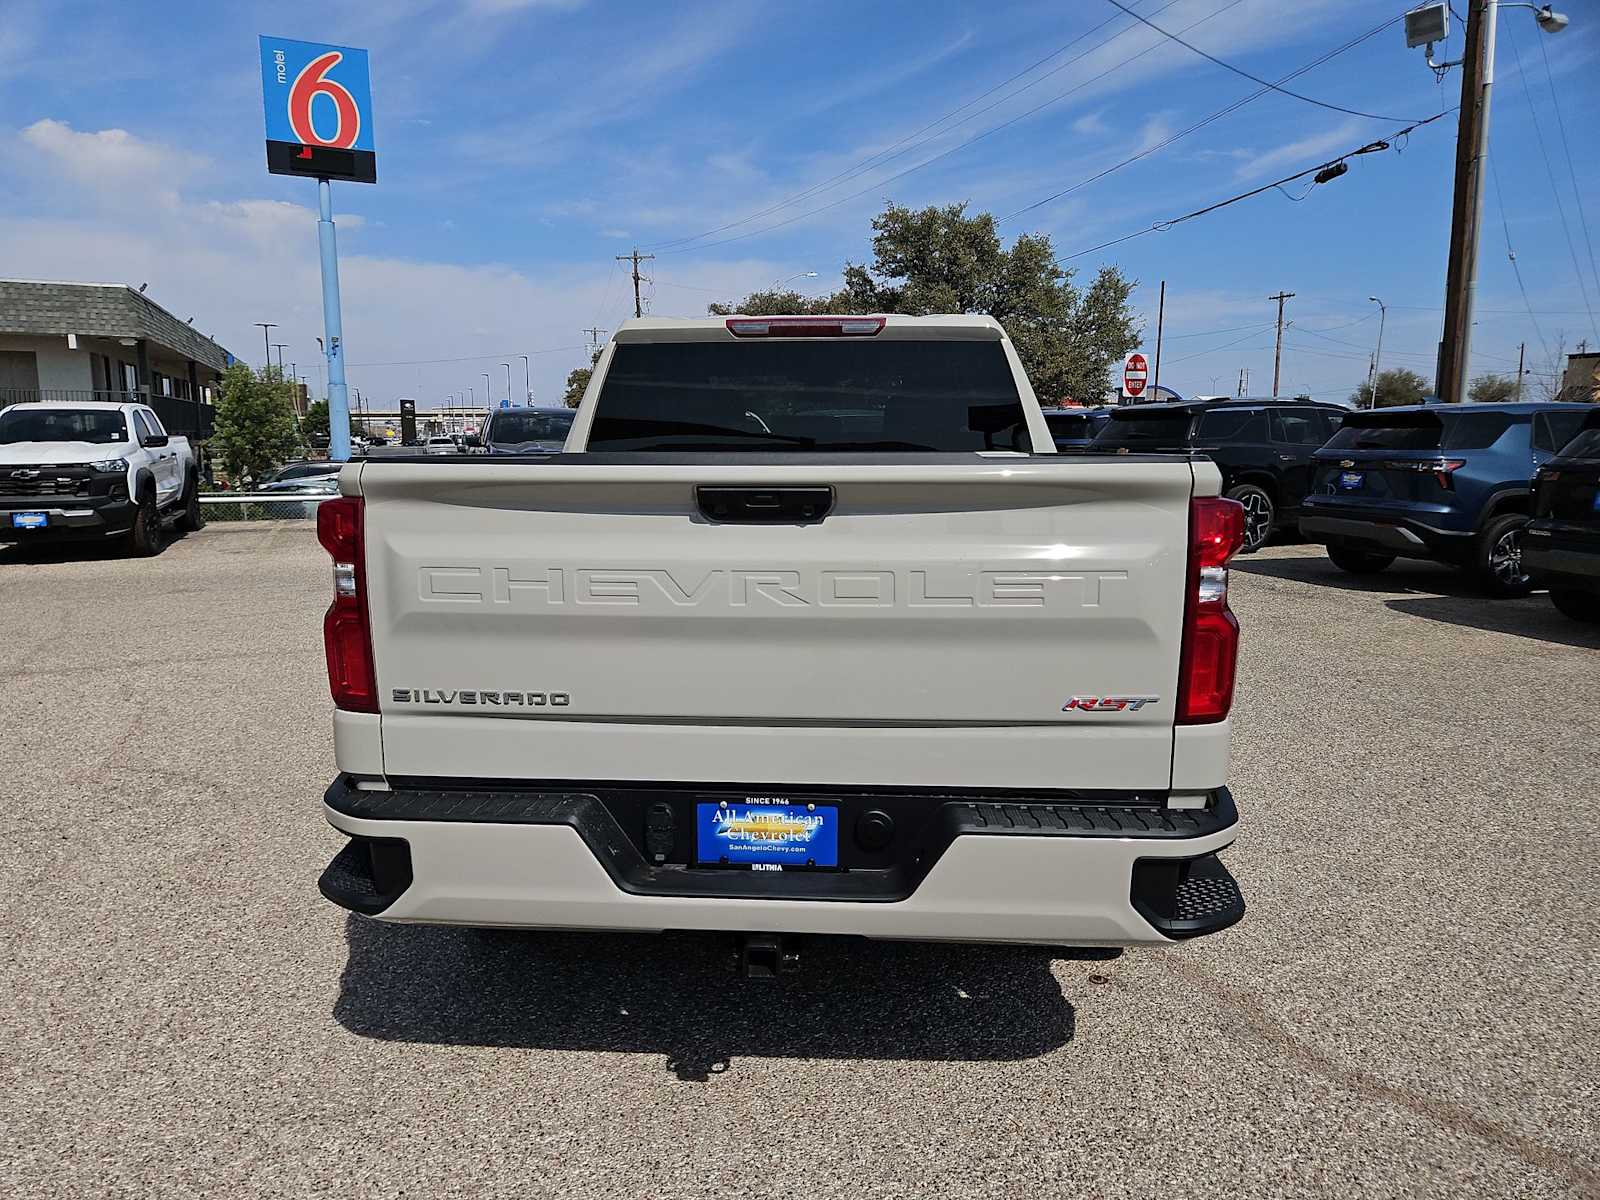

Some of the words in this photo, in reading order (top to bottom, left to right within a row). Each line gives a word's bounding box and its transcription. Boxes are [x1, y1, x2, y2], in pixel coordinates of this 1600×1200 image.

[273, 50, 287, 83] motel
[287, 51, 361, 149] 6
[1128, 361, 1135, 369] DO
[1136, 361, 1145, 369] NOT
[1128, 380, 1143, 389] ENTER
[418, 566, 1128, 607] CHEVROLET
[392, 688, 570, 706] SILVERADO
[1062, 695, 1160, 711] RST
[745, 797, 770, 805] SINCE
[712, 809, 737, 824] All
[744, 810, 824, 826] American
[727, 826, 811, 842] Chevrolet
[729, 844, 806, 853] SanAngeloChevy.com
